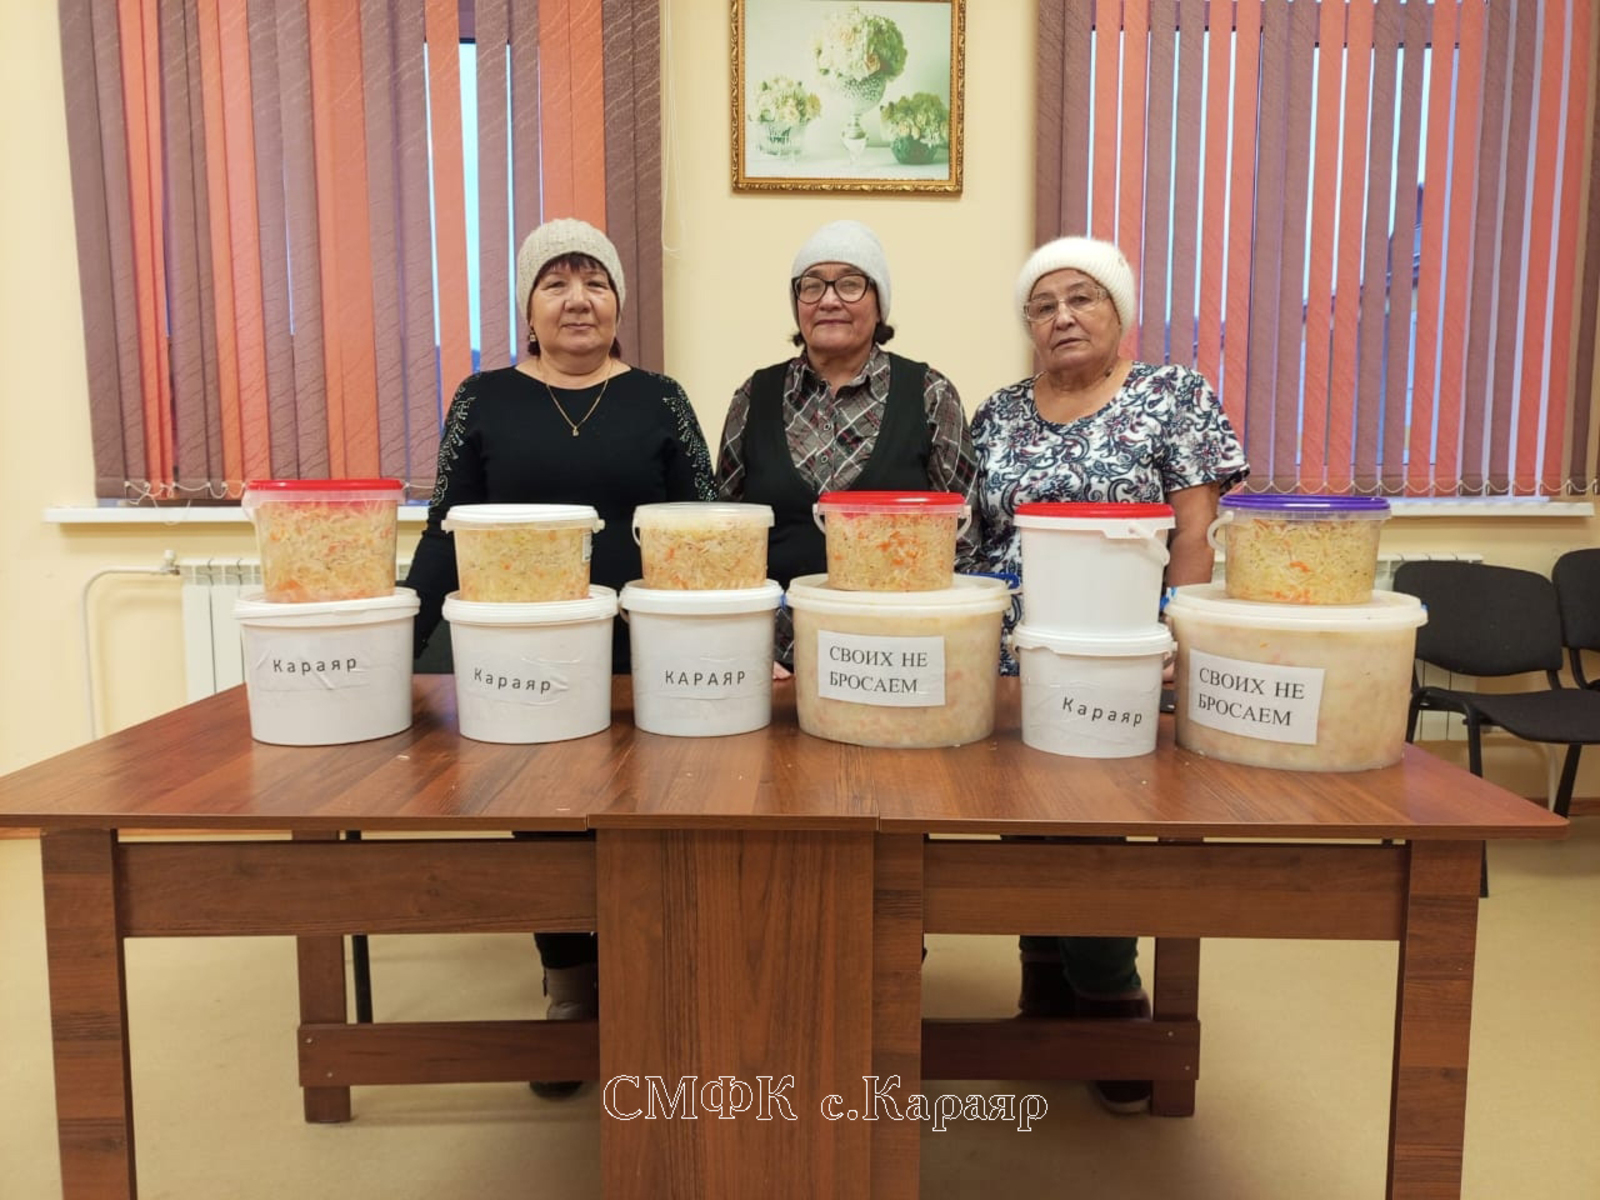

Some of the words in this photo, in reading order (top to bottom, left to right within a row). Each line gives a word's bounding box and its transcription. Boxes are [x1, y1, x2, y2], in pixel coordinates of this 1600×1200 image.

[272, 656, 358, 674] Караяр
[829, 646, 894, 667] СВОИХ
[902, 652, 929, 668] НЕ
[474, 668, 552, 694] Караяр
[665, 669, 747, 686] КАРАЯР
[829, 674, 919, 695] БРОСАЕМ
[1199, 668, 1266, 695] СВОИХ
[1275, 682, 1305, 700] НЕ
[1062, 696, 1143, 726] Караяр
[1199, 694, 1292, 726] БРОСАЕМ
